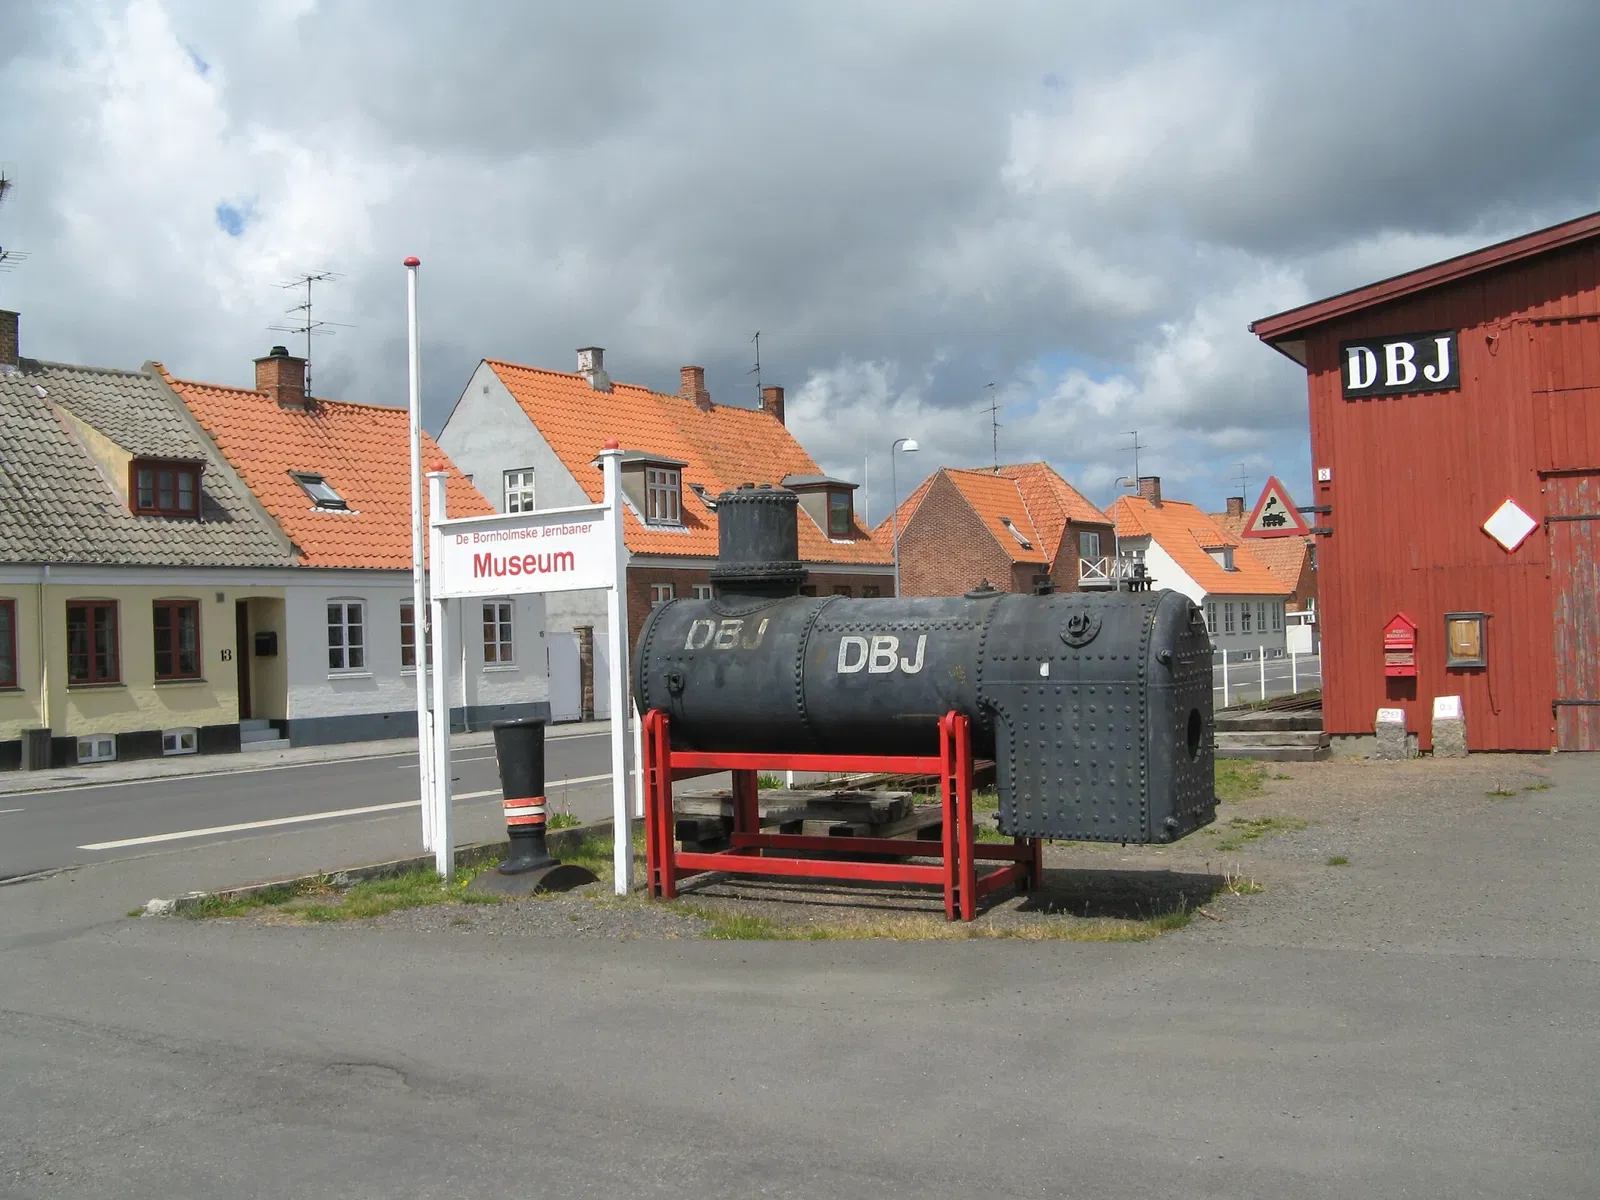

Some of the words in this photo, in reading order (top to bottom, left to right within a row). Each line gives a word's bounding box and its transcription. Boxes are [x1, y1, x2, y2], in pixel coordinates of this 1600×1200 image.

[1346, 337, 1451, 390] DBJ
[1321, 470, 1328, 480] 8
[456, 534, 469, 545] De
[473, 528, 538, 544] Bornholmske
[541, 523, 593, 538] Jernbaner
[473, 551, 575, 578] Museum
[684, 618, 770, 650] DBJ
[220, 648, 232, 662] 13
[837, 634, 928, 674] DBJ
